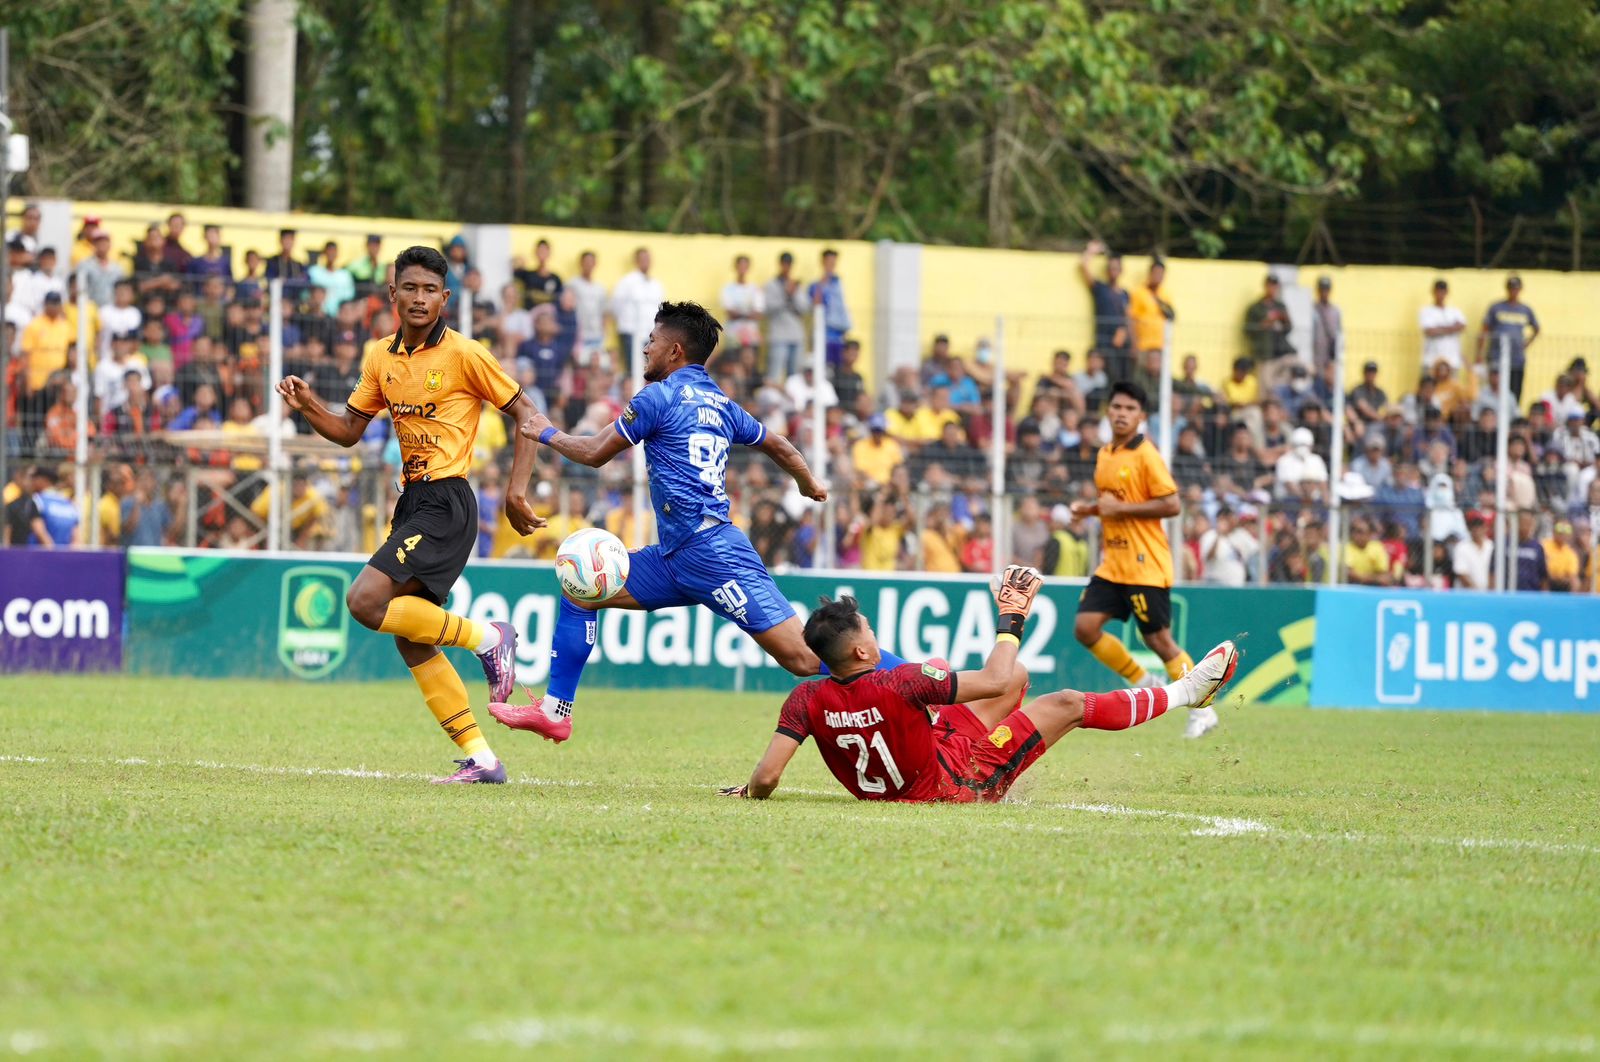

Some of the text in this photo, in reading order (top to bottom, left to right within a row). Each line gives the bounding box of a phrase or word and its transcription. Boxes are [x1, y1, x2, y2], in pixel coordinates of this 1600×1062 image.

[403, 534, 423, 551] 4
[609, 545, 627, 558] SPEC
[711, 579, 748, 613] 90
[1414, 620, 1600, 700] LIB Sup
[836, 730, 905, 794] 21
